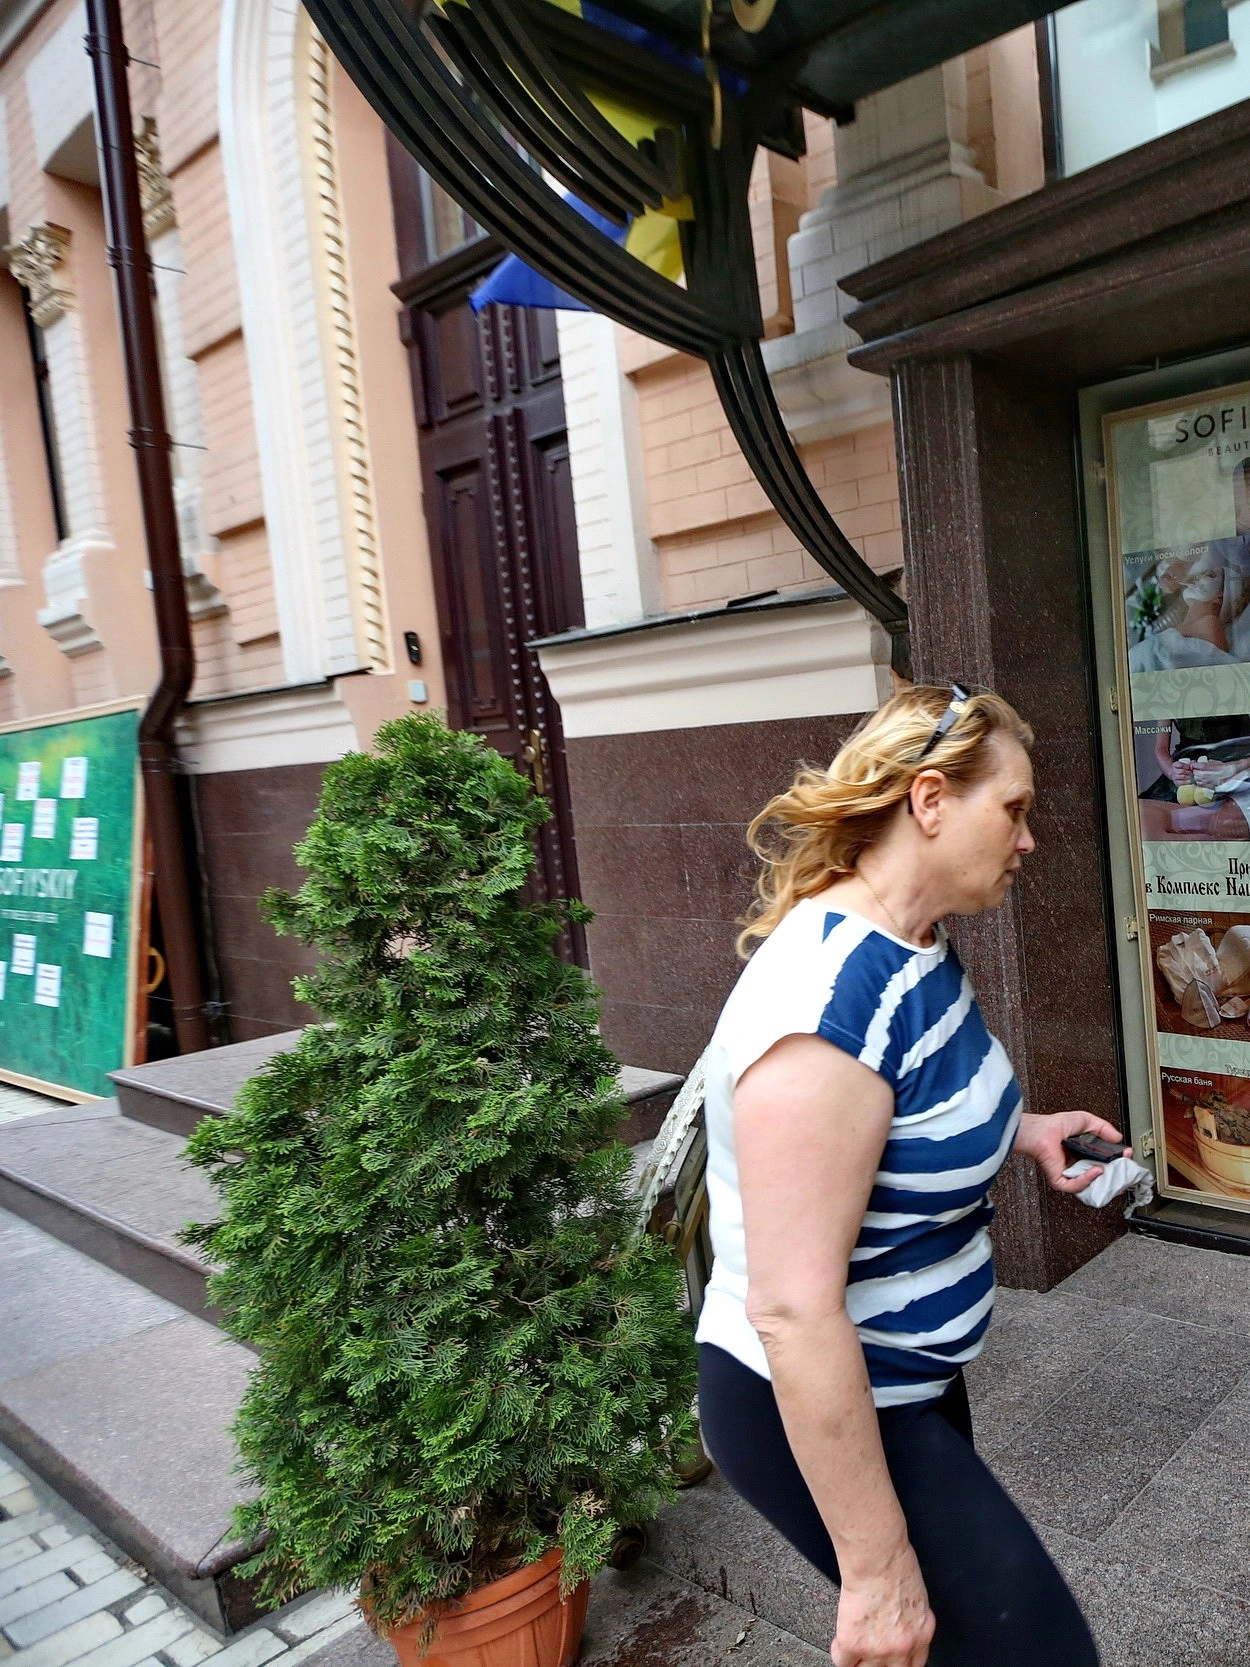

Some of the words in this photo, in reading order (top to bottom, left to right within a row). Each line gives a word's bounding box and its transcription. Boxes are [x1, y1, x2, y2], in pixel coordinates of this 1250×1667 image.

[1124, 555, 1153, 566] Услуги
[1134, 726, 1172, 735] Массажи
[1146, 883, 1152, 894] в
[1156, 875, 1220, 896] Комплекс
[1149, 913, 1181, 923] Римская
[1183, 916, 1213, 926] парная
[1161, 1071, 1192, 1084] Русская
[1193, 1076, 1213, 1087] баня
